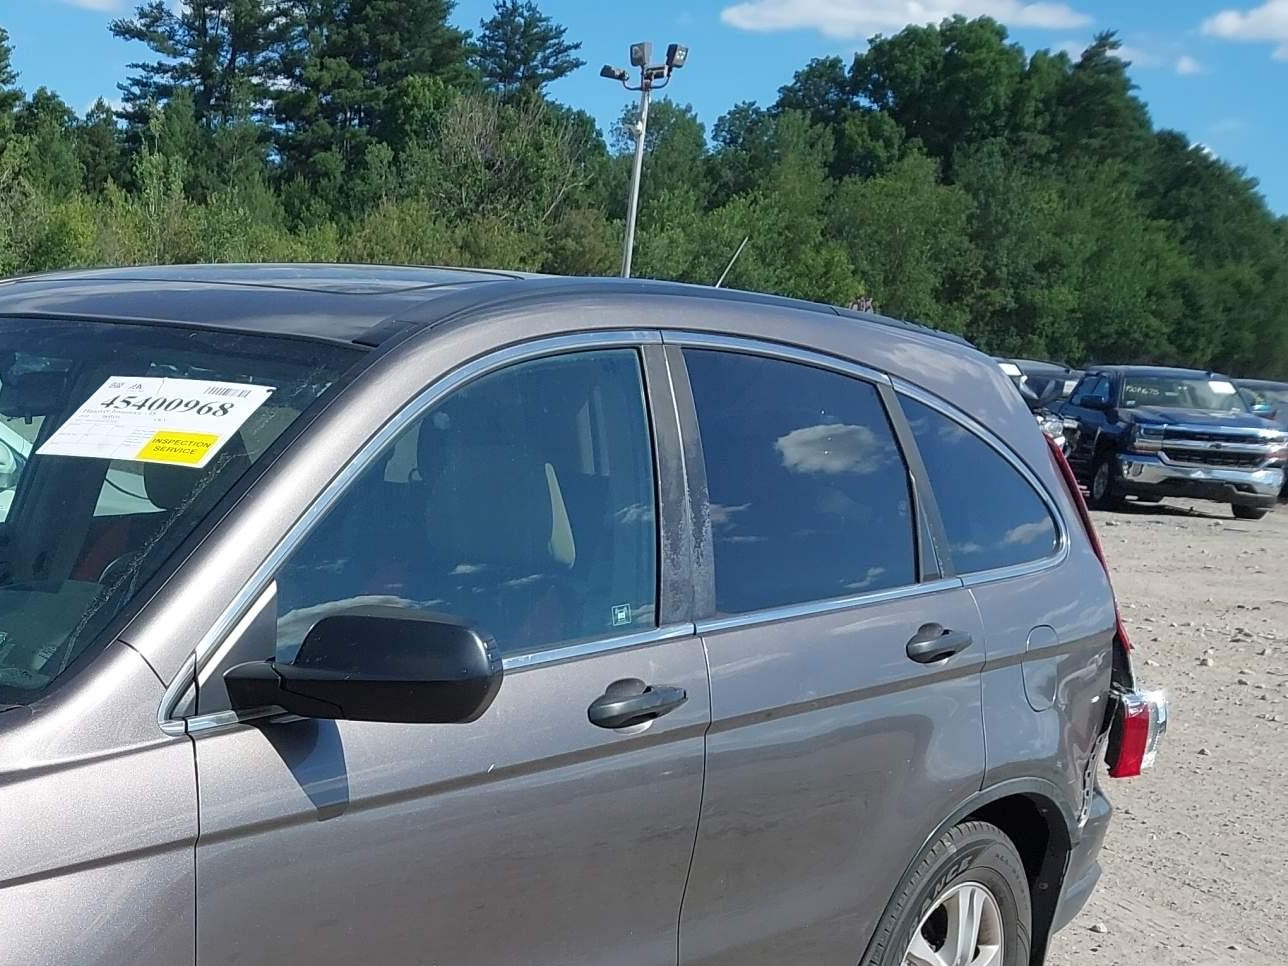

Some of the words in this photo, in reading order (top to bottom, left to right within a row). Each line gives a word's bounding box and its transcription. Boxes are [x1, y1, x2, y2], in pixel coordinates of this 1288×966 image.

[100, 394, 235, 417] 45400968
[152, 438, 213, 449] INSPECTION
[152, 446, 198, 455] SERVICE
